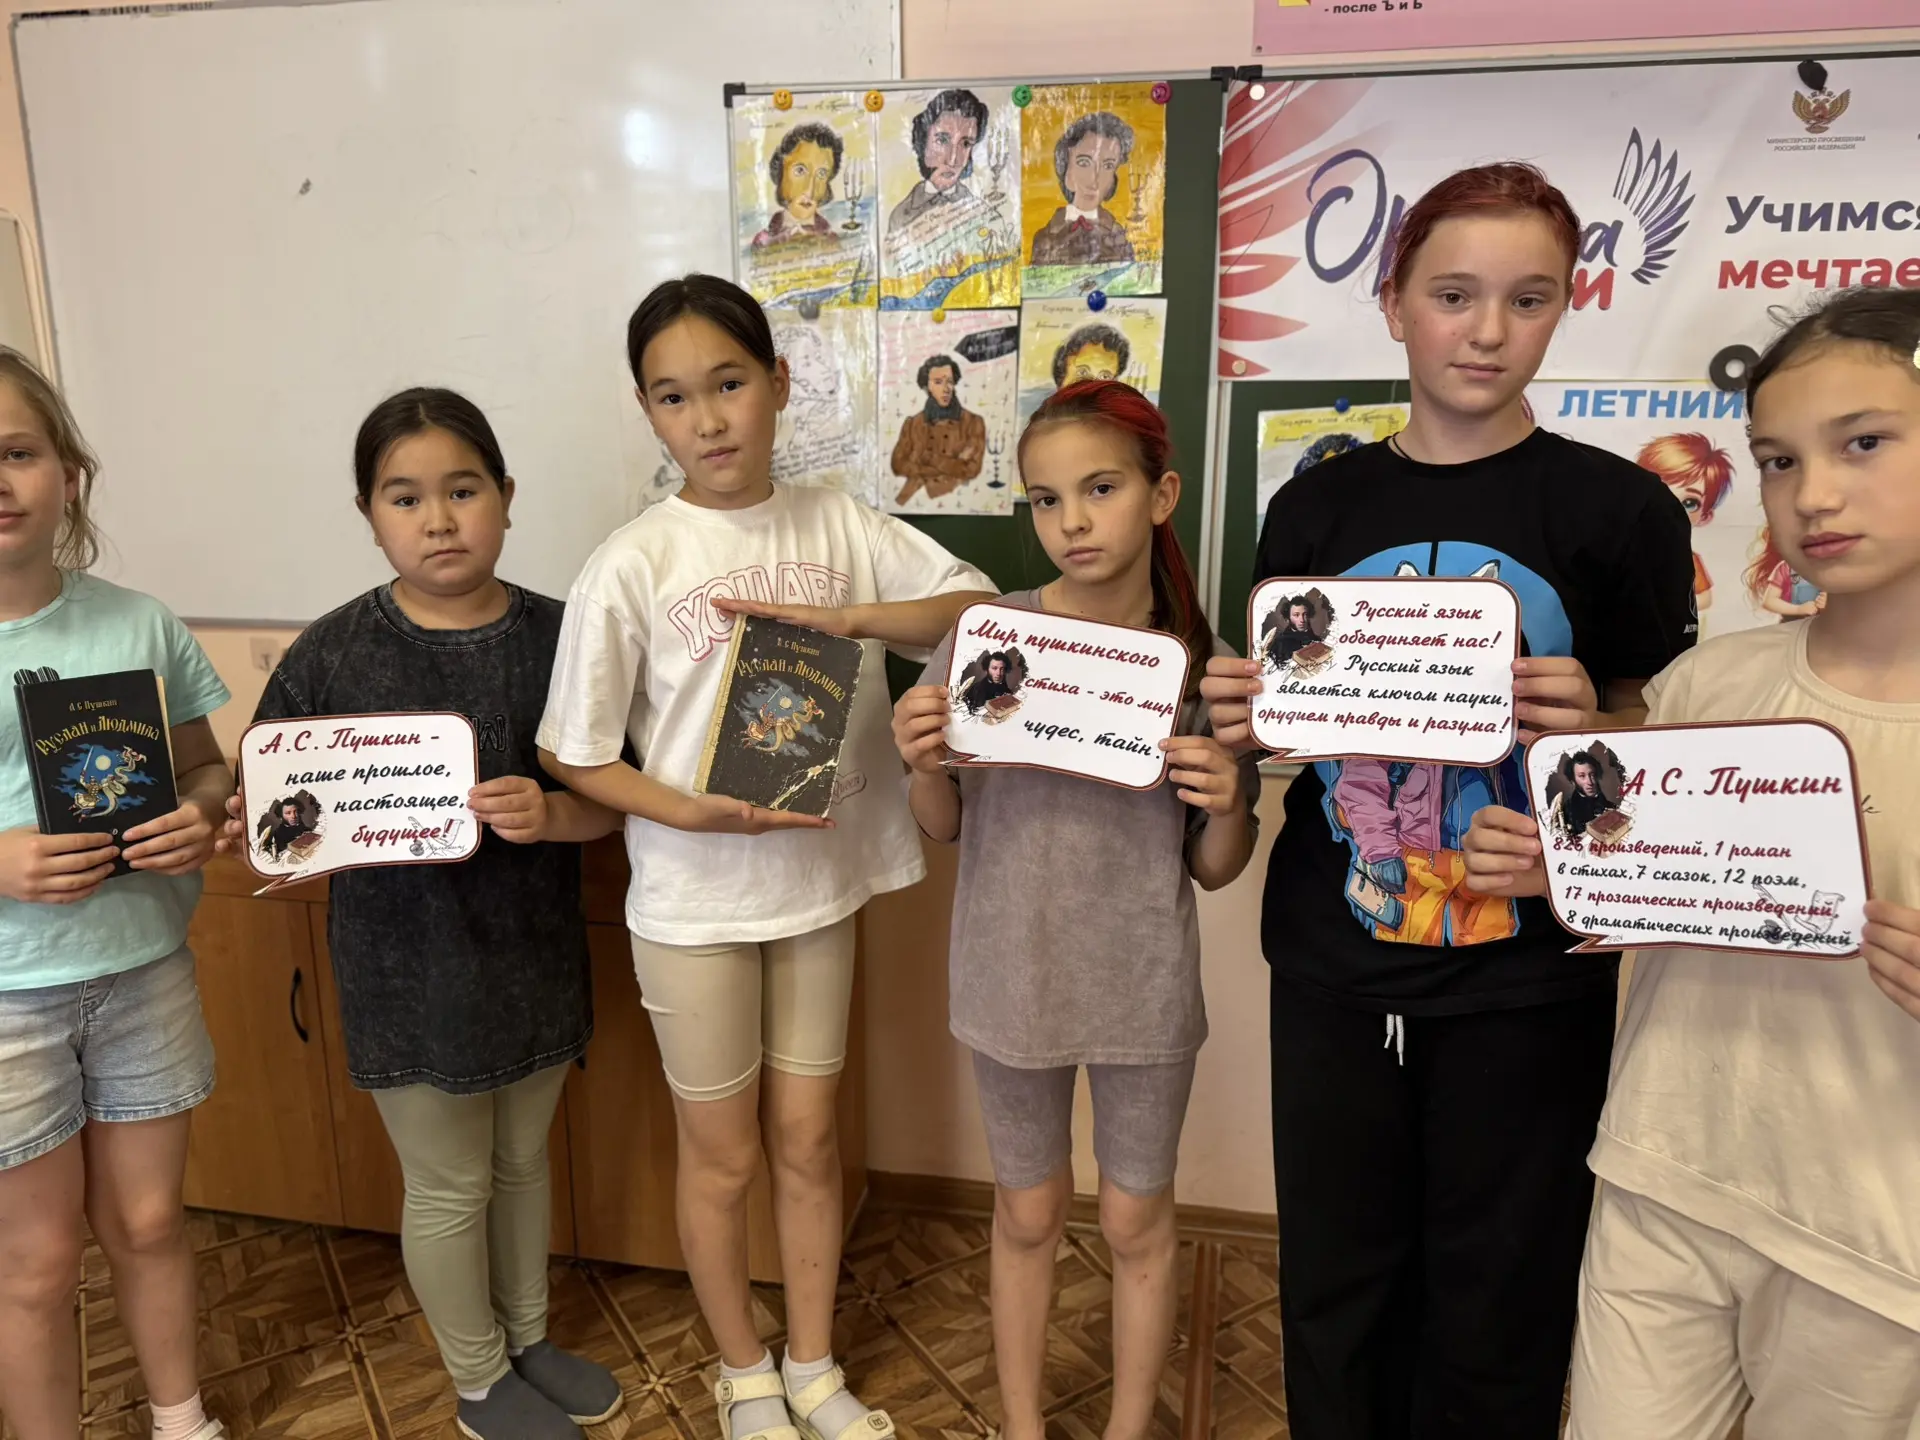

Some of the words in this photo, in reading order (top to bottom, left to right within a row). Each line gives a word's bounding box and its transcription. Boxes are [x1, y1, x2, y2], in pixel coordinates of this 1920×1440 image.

[1333, 3, 1377, 14] после
[1382, 0, 1395, 11] Ъ
[1399, 1, 1408, 10] и
[1351, 600, 1430, 622] Русский
[1434, 606, 1483, 620] язык
[967, 618, 1018, 648] Мир
[1024, 633, 1160, 668] пушкинского
[1339, 629, 1448, 650] объединяет
[1453, 630, 1503, 649] нас!
[1344, 654, 1421, 674] Русский
[1426, 662, 1474, 676] язык
[737, 659, 786, 679] Руслан
[794, 660, 846, 702] Людмила
[85, 699, 118, 711] Пушкин
[1025, 676, 1081, 696] стиха
[1100, 689, 1134, 706] это
[1137, 699, 1175, 719] мир
[1277, 682, 1361, 699] является
[1367, 687, 1438, 702] ключом
[1443, 691, 1509, 708] науки,
[1258, 707, 1329, 725] орудием
[1334, 711, 1403, 728] правды
[1407, 718, 1419, 728] и
[1423, 716, 1511, 737] разума!
[35, 721, 90, 756] Руслан
[97, 715, 160, 741] Людмила
[327, 727, 421, 753] Пушкин
[1023, 719, 1084, 742] чудес,
[1094, 732, 1161, 760] тайн.
[285, 768, 347, 786] наше
[352, 762, 451, 785] прошлое,
[1703, 766, 1843, 803] Пушкин
[333, 793, 466, 814] настоящее,
[351, 818, 454, 848] будущее!
[1589, 839, 1708, 858] произведений,
[1714, 840, 1724, 857] 1
[1727, 845, 1792, 861] роман
[1557, 862, 1567, 876] в
[1570, 864, 1633, 880] стихах,
[1635, 864, 1648, 880] 7
[1653, 870, 1717, 885] сказок,
[1723, 868, 1747, 885] 12
[1750, 874, 1807, 889] поэм,
[1564, 885, 1583, 900] 17
[1587, 889, 1698, 909] прозаических
[1566, 910, 1577, 924] 8
[1580, 914, 1713, 936] драматических
